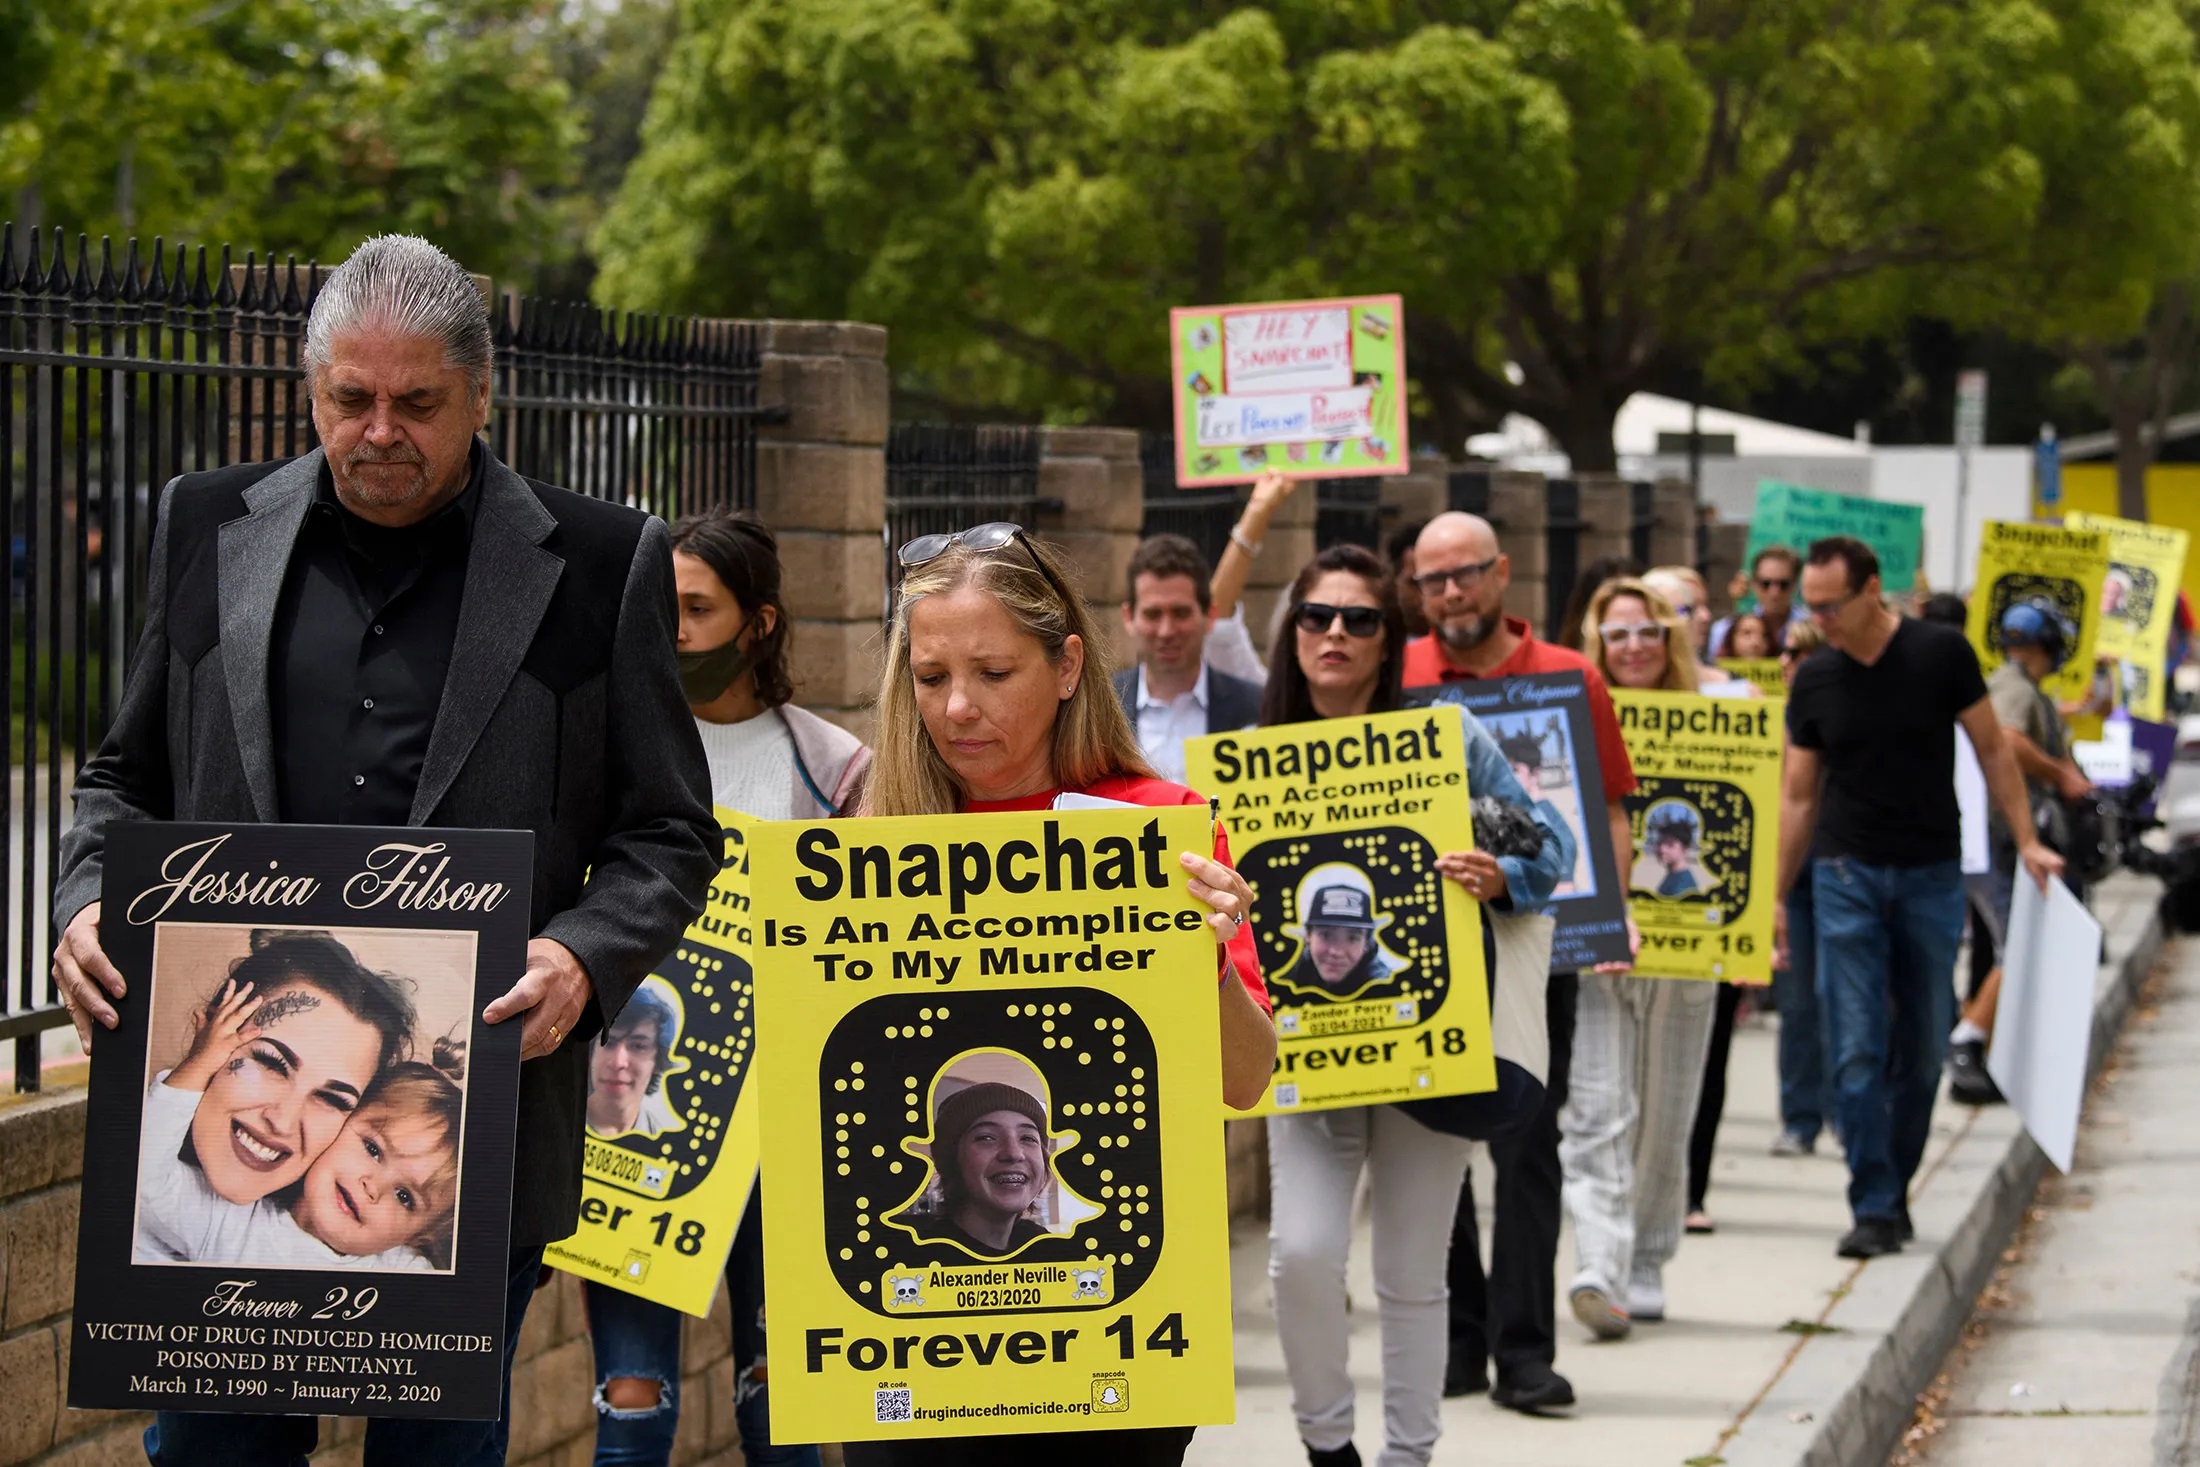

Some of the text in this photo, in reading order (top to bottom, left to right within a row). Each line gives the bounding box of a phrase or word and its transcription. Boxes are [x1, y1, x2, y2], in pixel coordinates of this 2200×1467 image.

[1254, 315, 1319, 341] HEY
[1617, 703, 1769, 740] napchat
[1213, 717, 1442, 784] Snapchat
[1674, 757, 1755, 774] Murder
[1233, 772, 1461, 810] An Accomplice
[1227, 797, 1433, 833] To My Murder
[126, 833, 511, 926] Jessica Filson
[795, 817, 1169, 914] Snapchat
[764, 906, 1202, 946] Is An Accomplice
[1715, 933, 1755, 955] 16
[813, 944, 1156, 985] To My Murder
[1273, 1028, 1467, 1074] rever 18
[650, 1211, 706, 1256] 18
[929, 1267, 1067, 1288] Alexander Neville
[202, 1280, 379, 1321] Forever 29
[957, 1288, 1041, 1308] 06/23/2020
[86, 1323, 493, 1352] VICTIM OF DRUG INDUCED HOMICIDE
[805, 1312, 1190, 1374] Forever 14
[156, 1351, 418, 1376] POISONED BY FENTANYL
[1092, 1371, 1126, 1379] snapcode
[129, 1375, 187, 1394] March
[194, 1378, 219, 1397] 12,
[226, 1379, 268, 1396] 1990
[291, 1380, 361, 1404] January
[366, 1383, 392, 1403] 22,
[398, 1385, 442, 1402] 2020
[914, 1402, 1091, 1421] druginducedhomicide.org
